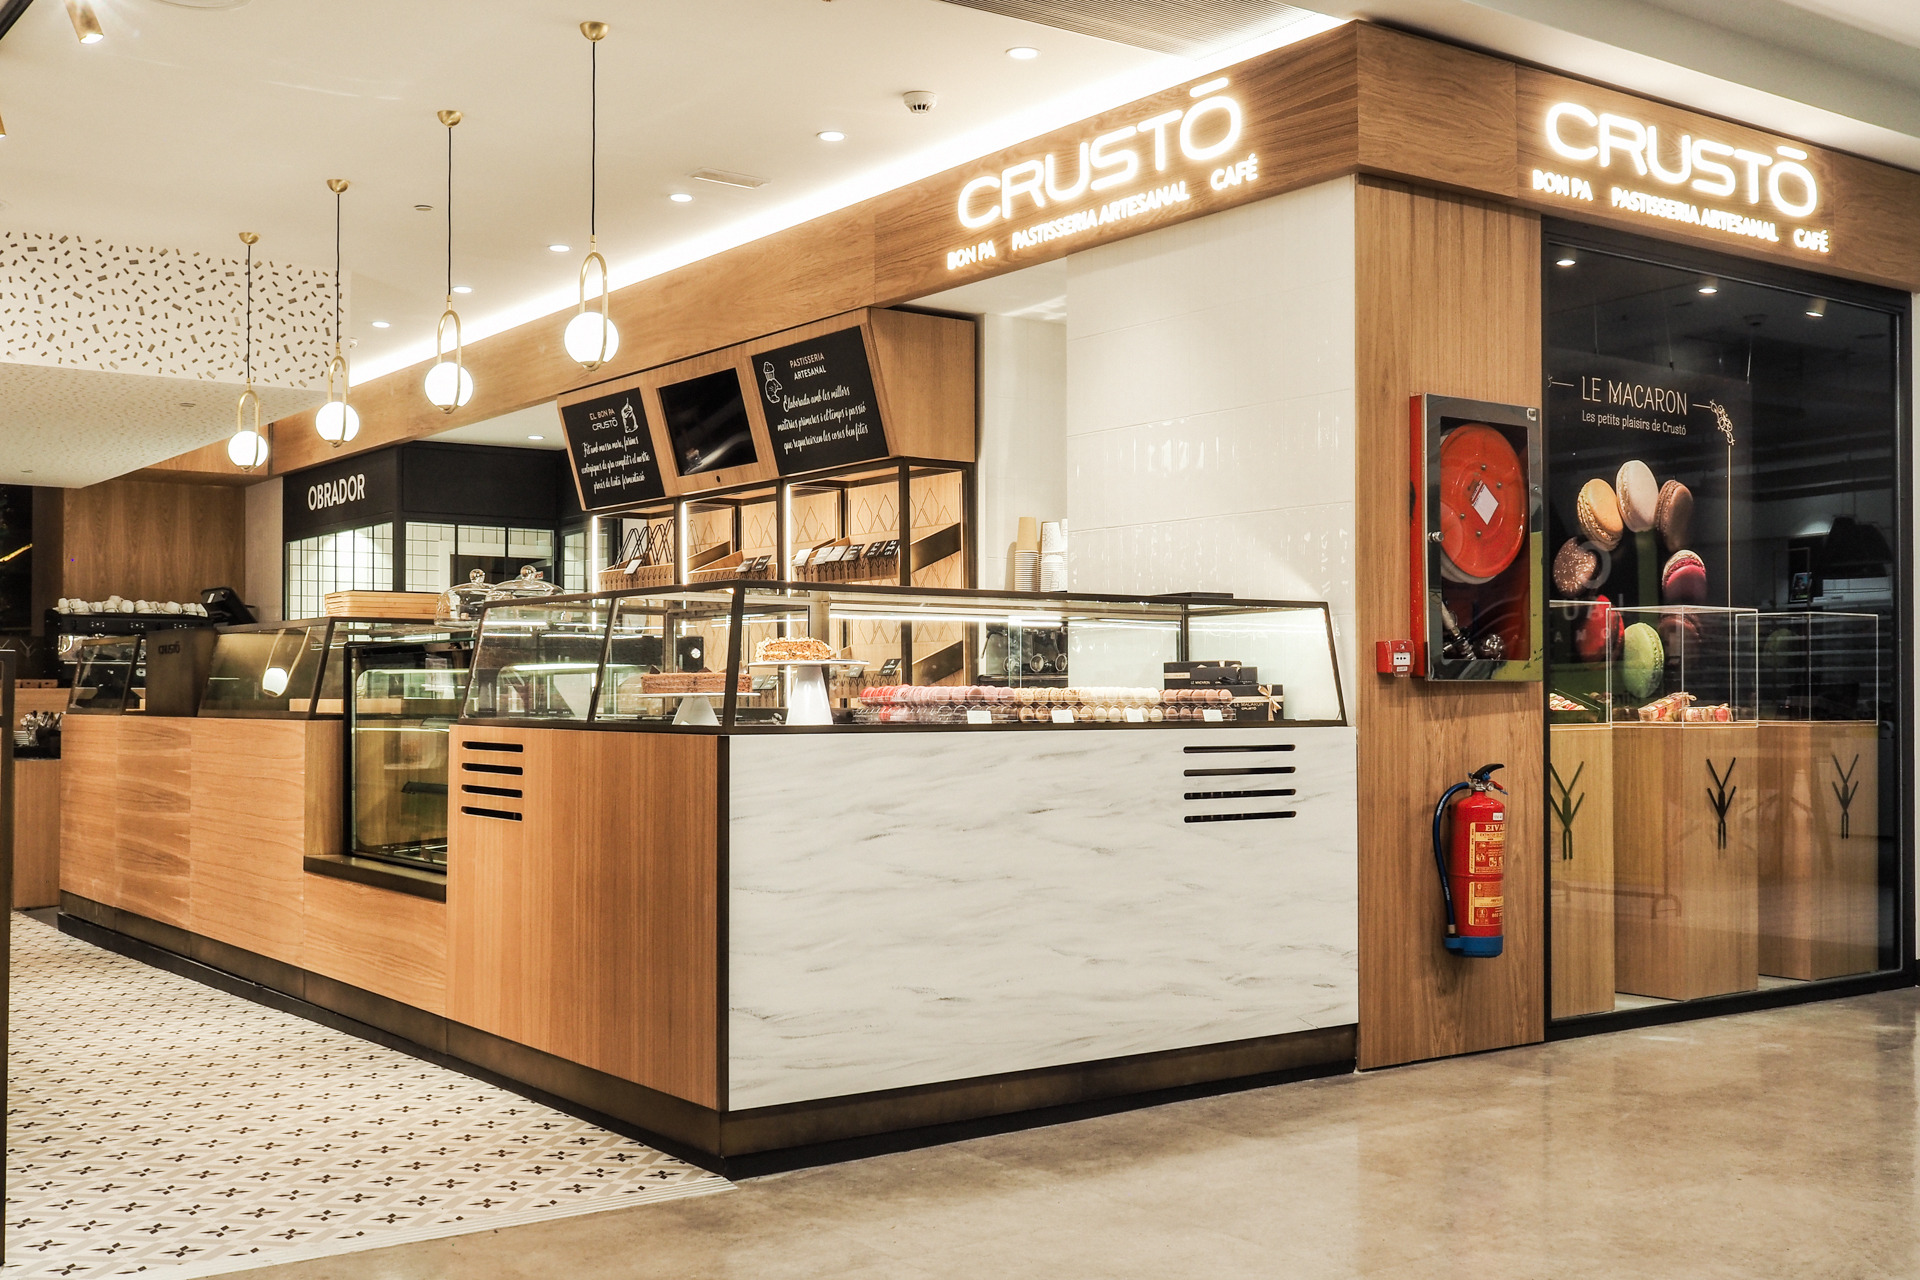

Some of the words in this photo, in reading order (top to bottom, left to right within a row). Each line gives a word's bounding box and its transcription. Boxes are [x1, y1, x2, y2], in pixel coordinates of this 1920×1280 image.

[946, 245, 977, 271] BON
[978, 240, 996, 261] PA
[1011, 208, 1098, 250] PASTISSERIA
[1098, 181, 1190, 226] ARTESANAL
[1210, 153, 1258, 192] CAFÉ
[1532, 168, 1570, 197] BON
[1571, 177, 1593, 201] PA
[1611, 186, 1700, 225] PASTISSERIA
[1700, 208, 1779, 242] ARTESANAL
[1793, 228, 1829, 253] CAFÉ
[789, 352, 825, 368] PASTISSERIA
[793, 365, 827, 380] ARTESANAL
[783, 393, 810, 412] Elaborada
[811, 389, 821, 403] amb
[822, 388, 830, 400] les
[831, 384, 850, 399] millors
[1582, 376, 1601, 402] LE
[1608, 379, 1687, 416] MACARON
[589, 412, 597, 420] EL
[597, 410, 608, 419] BON
[608, 408, 616, 417] PA
[798, 415, 820, 432] primeres
[829, 408, 845, 423] temps
[848, 401, 866, 421] passió
[1582, 409, 1596, 423] Les
[1597, 413, 1621, 427] petits
[1622, 415, 1650, 431] plaisirs
[1651, 418, 1661, 432] de
[783, 441, 793, 455] que
[822, 430, 831, 442] les
[832, 428, 845, 440] coses
[846, 424, 855, 437] ben
[308, 473, 365, 511] OBRADOR
